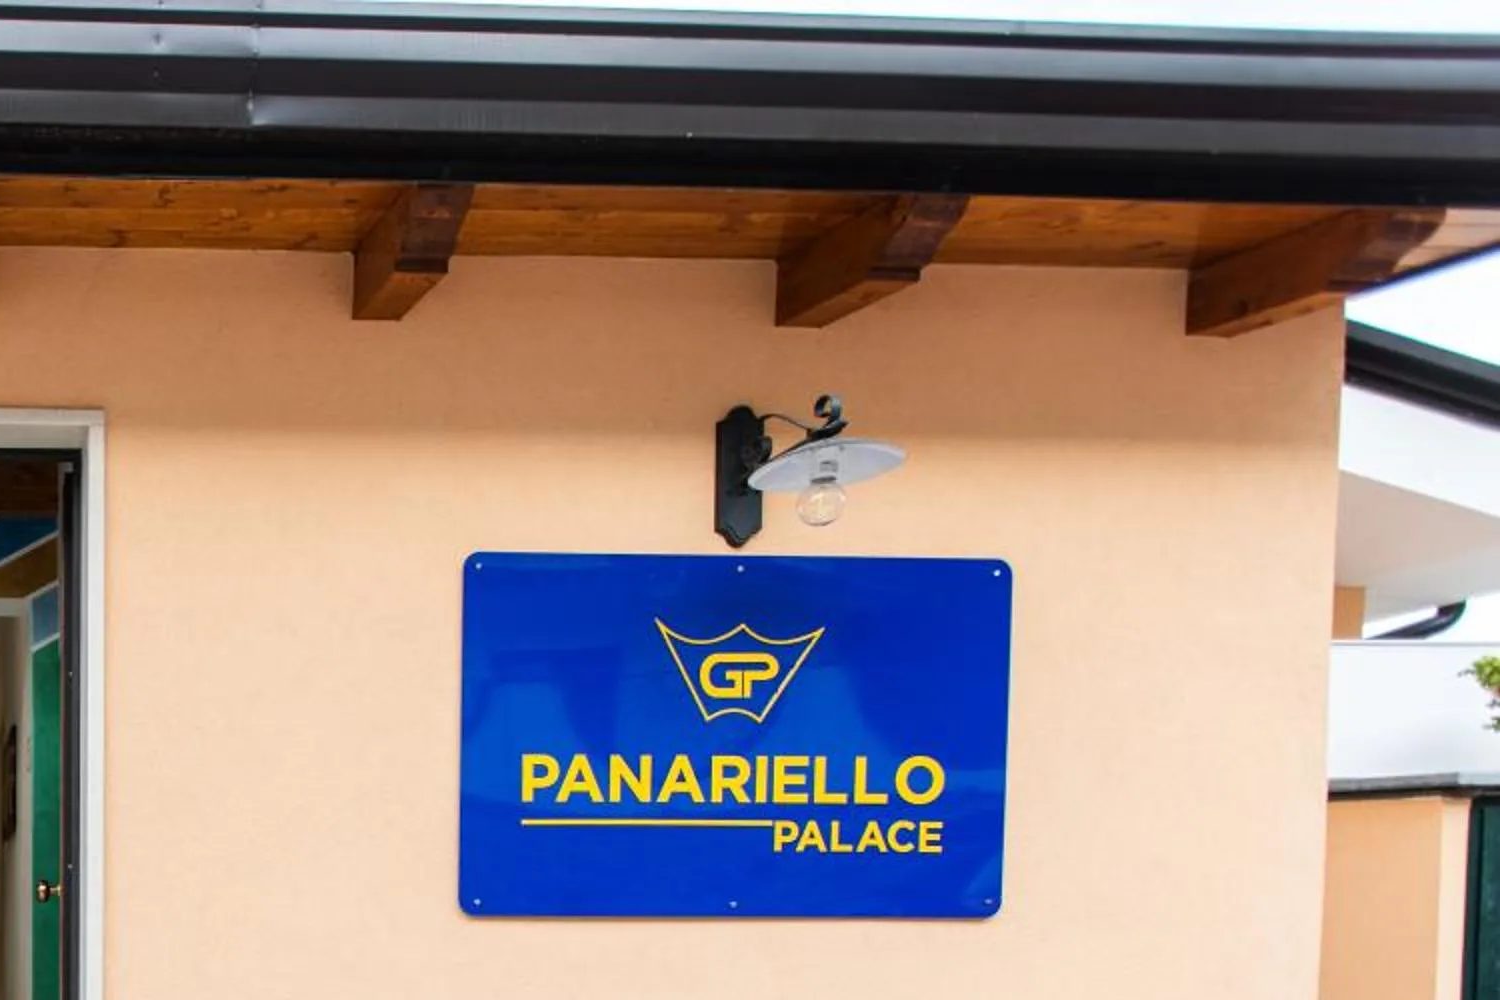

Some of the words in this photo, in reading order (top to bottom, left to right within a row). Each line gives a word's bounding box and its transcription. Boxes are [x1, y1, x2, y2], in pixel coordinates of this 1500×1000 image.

[699, 652, 780, 699] GP
[520, 753, 946, 805] PANARIELLO
[772, 819, 944, 854] PALACE
